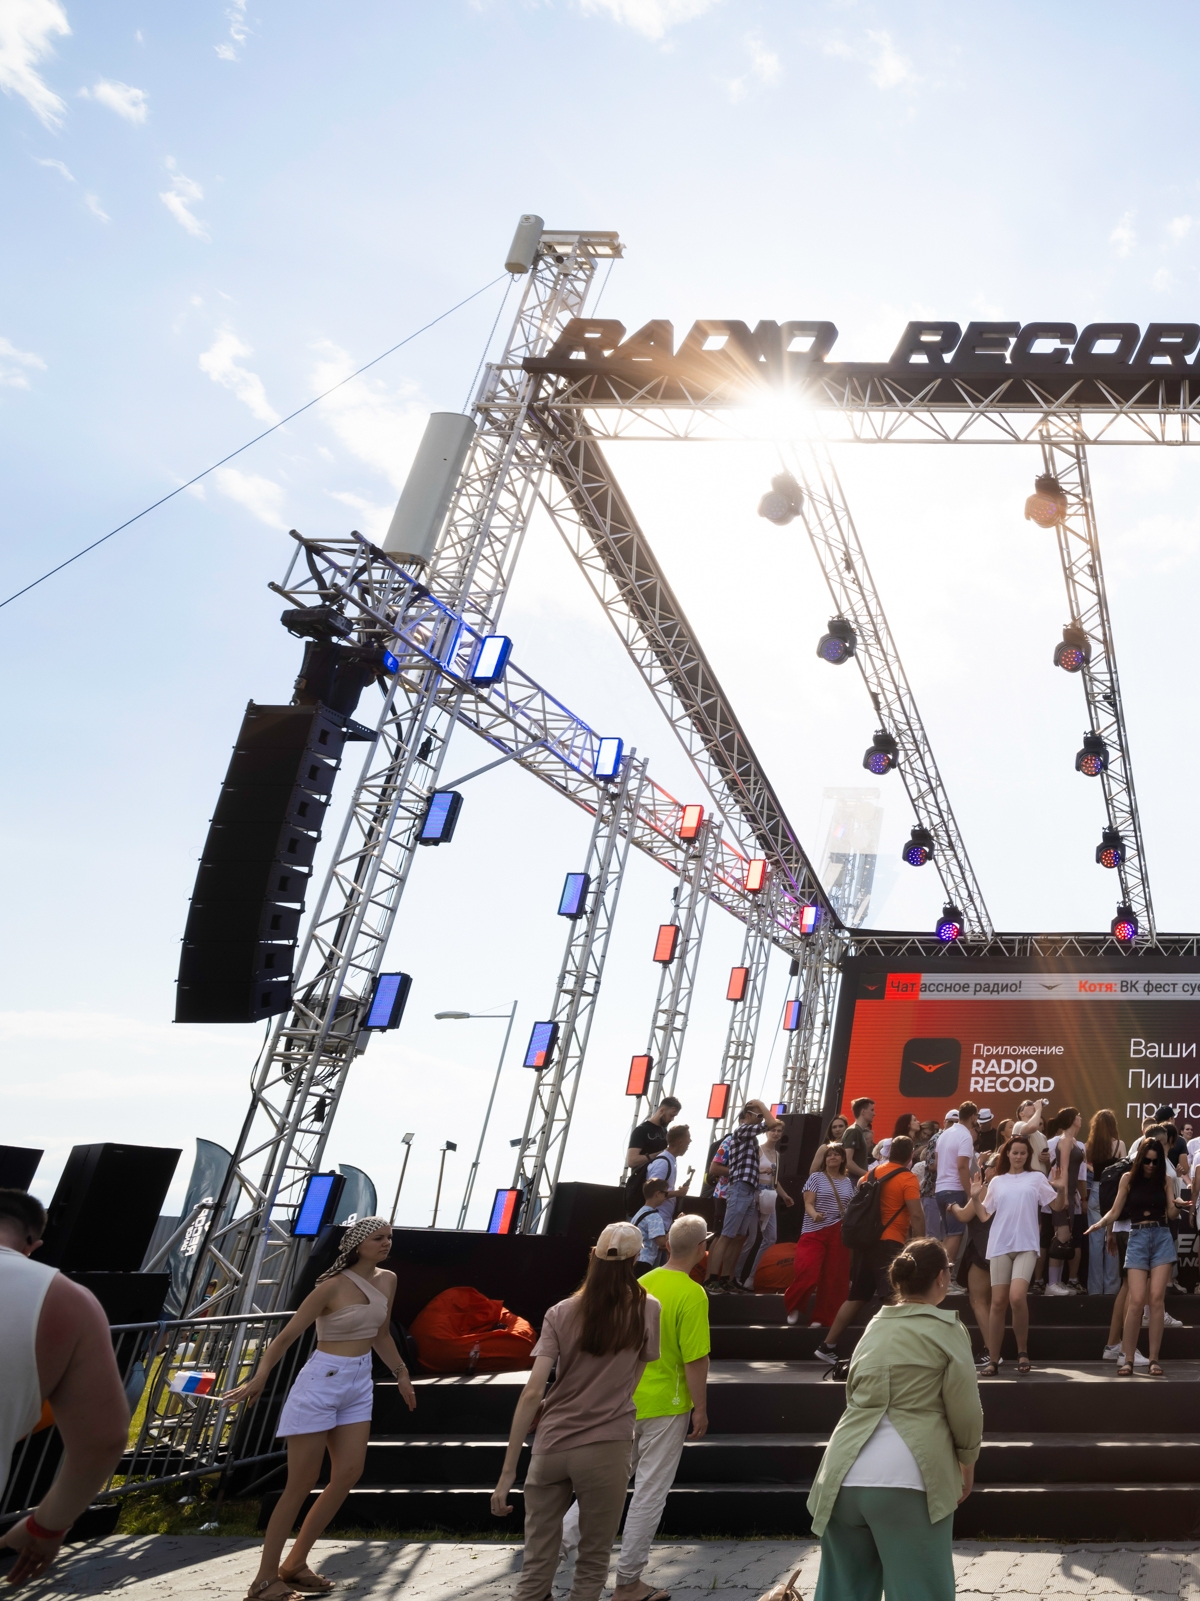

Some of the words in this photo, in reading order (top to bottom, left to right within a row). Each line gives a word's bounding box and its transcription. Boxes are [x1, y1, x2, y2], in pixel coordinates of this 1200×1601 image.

[548, 318, 839, 362] RADIO
[890, 980, 917, 993] Чат
[973, 980, 1022, 996] радио!
[1078, 980, 1118, 993] Котя:
[1120, 980, 1139, 993] ВК
[1143, 980, 1178, 996] фест
[973, 1043, 1064, 1058] Приложение
[1130, 1038, 1197, 1058] Ваши
[971, 1058, 1037, 1075] RADIO
[969, 1076, 1055, 1093] RECORD
